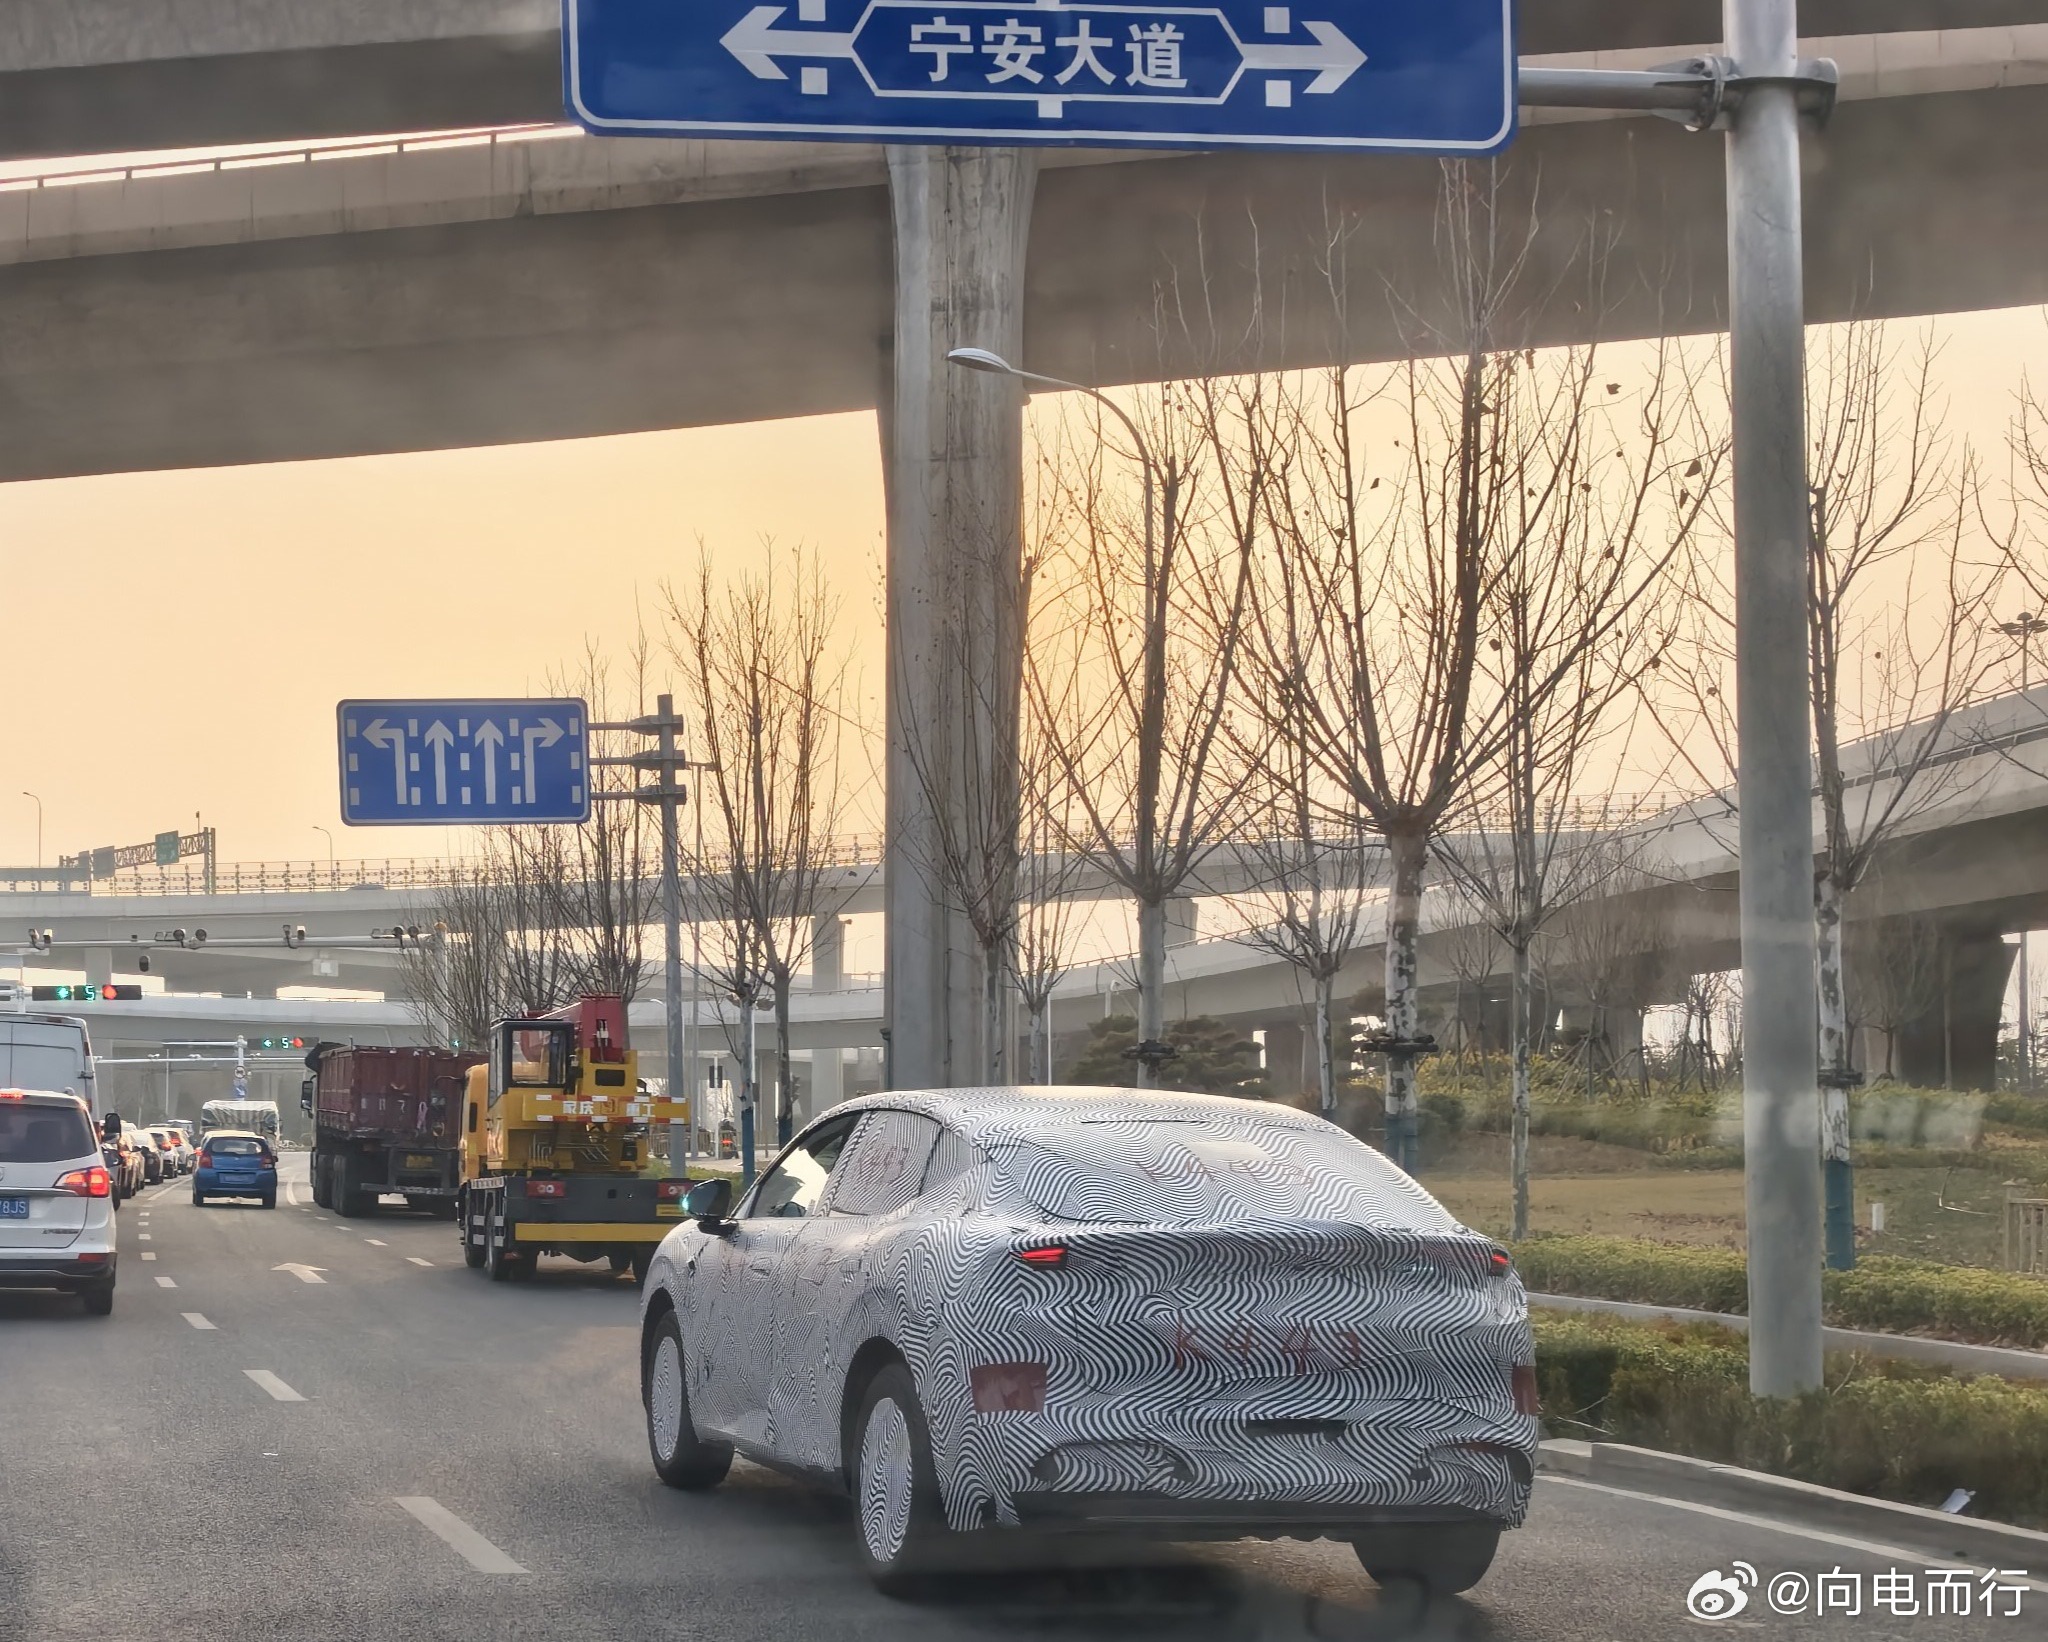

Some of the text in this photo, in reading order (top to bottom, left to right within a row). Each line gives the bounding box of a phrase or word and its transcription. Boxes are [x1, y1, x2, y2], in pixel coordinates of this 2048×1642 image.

[909, 16, 1188, 88] 宁安大道
[85, 985, 95, 1001] 5
[281, 1037, 290, 1049] 5
[0, 1200, 26, 1214] 8JS
